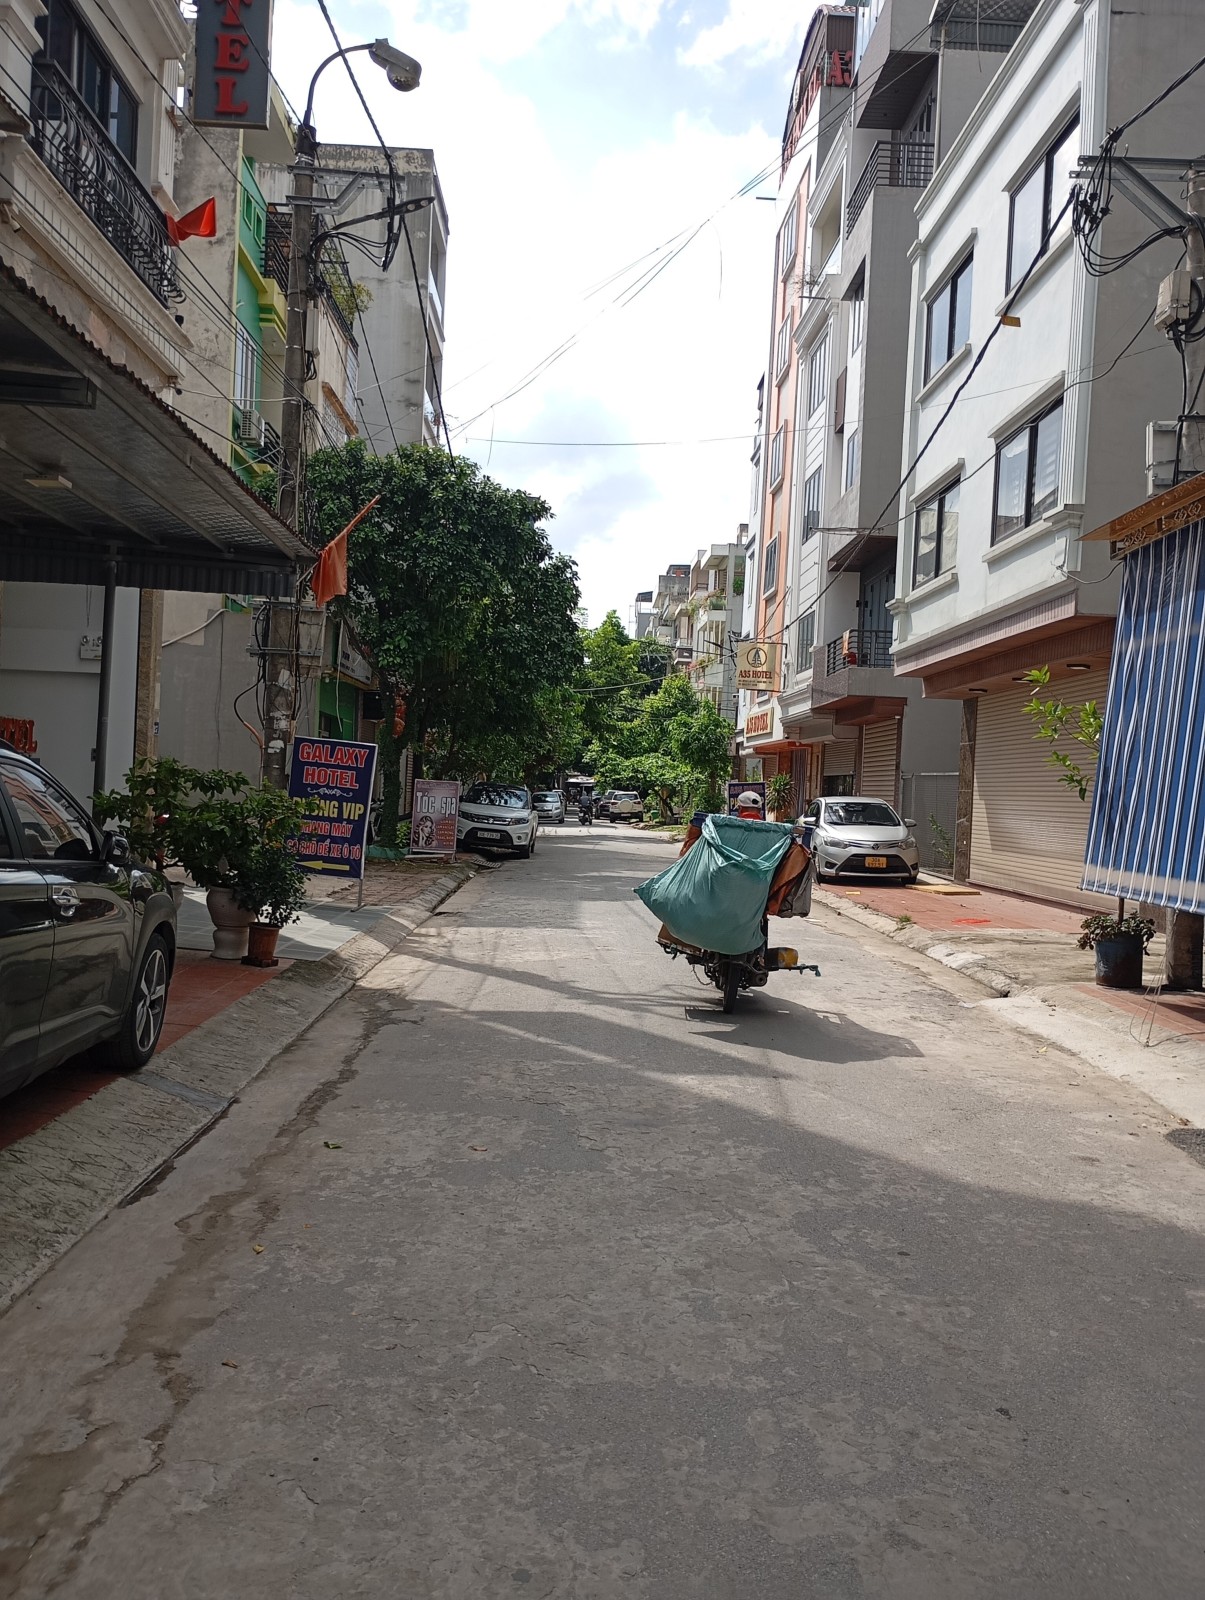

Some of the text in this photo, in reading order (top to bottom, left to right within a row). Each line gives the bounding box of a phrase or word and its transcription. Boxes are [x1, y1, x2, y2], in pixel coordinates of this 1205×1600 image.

[752, 670, 773, 679] HOTEL
[299, 742, 369, 767] GALAXY
[303, 766, 359, 789] HOTEL
[342, 802, 365, 820] VIP
[416, 791, 456, 817] Tóc spa
[330, 843, 342, 858] XE
